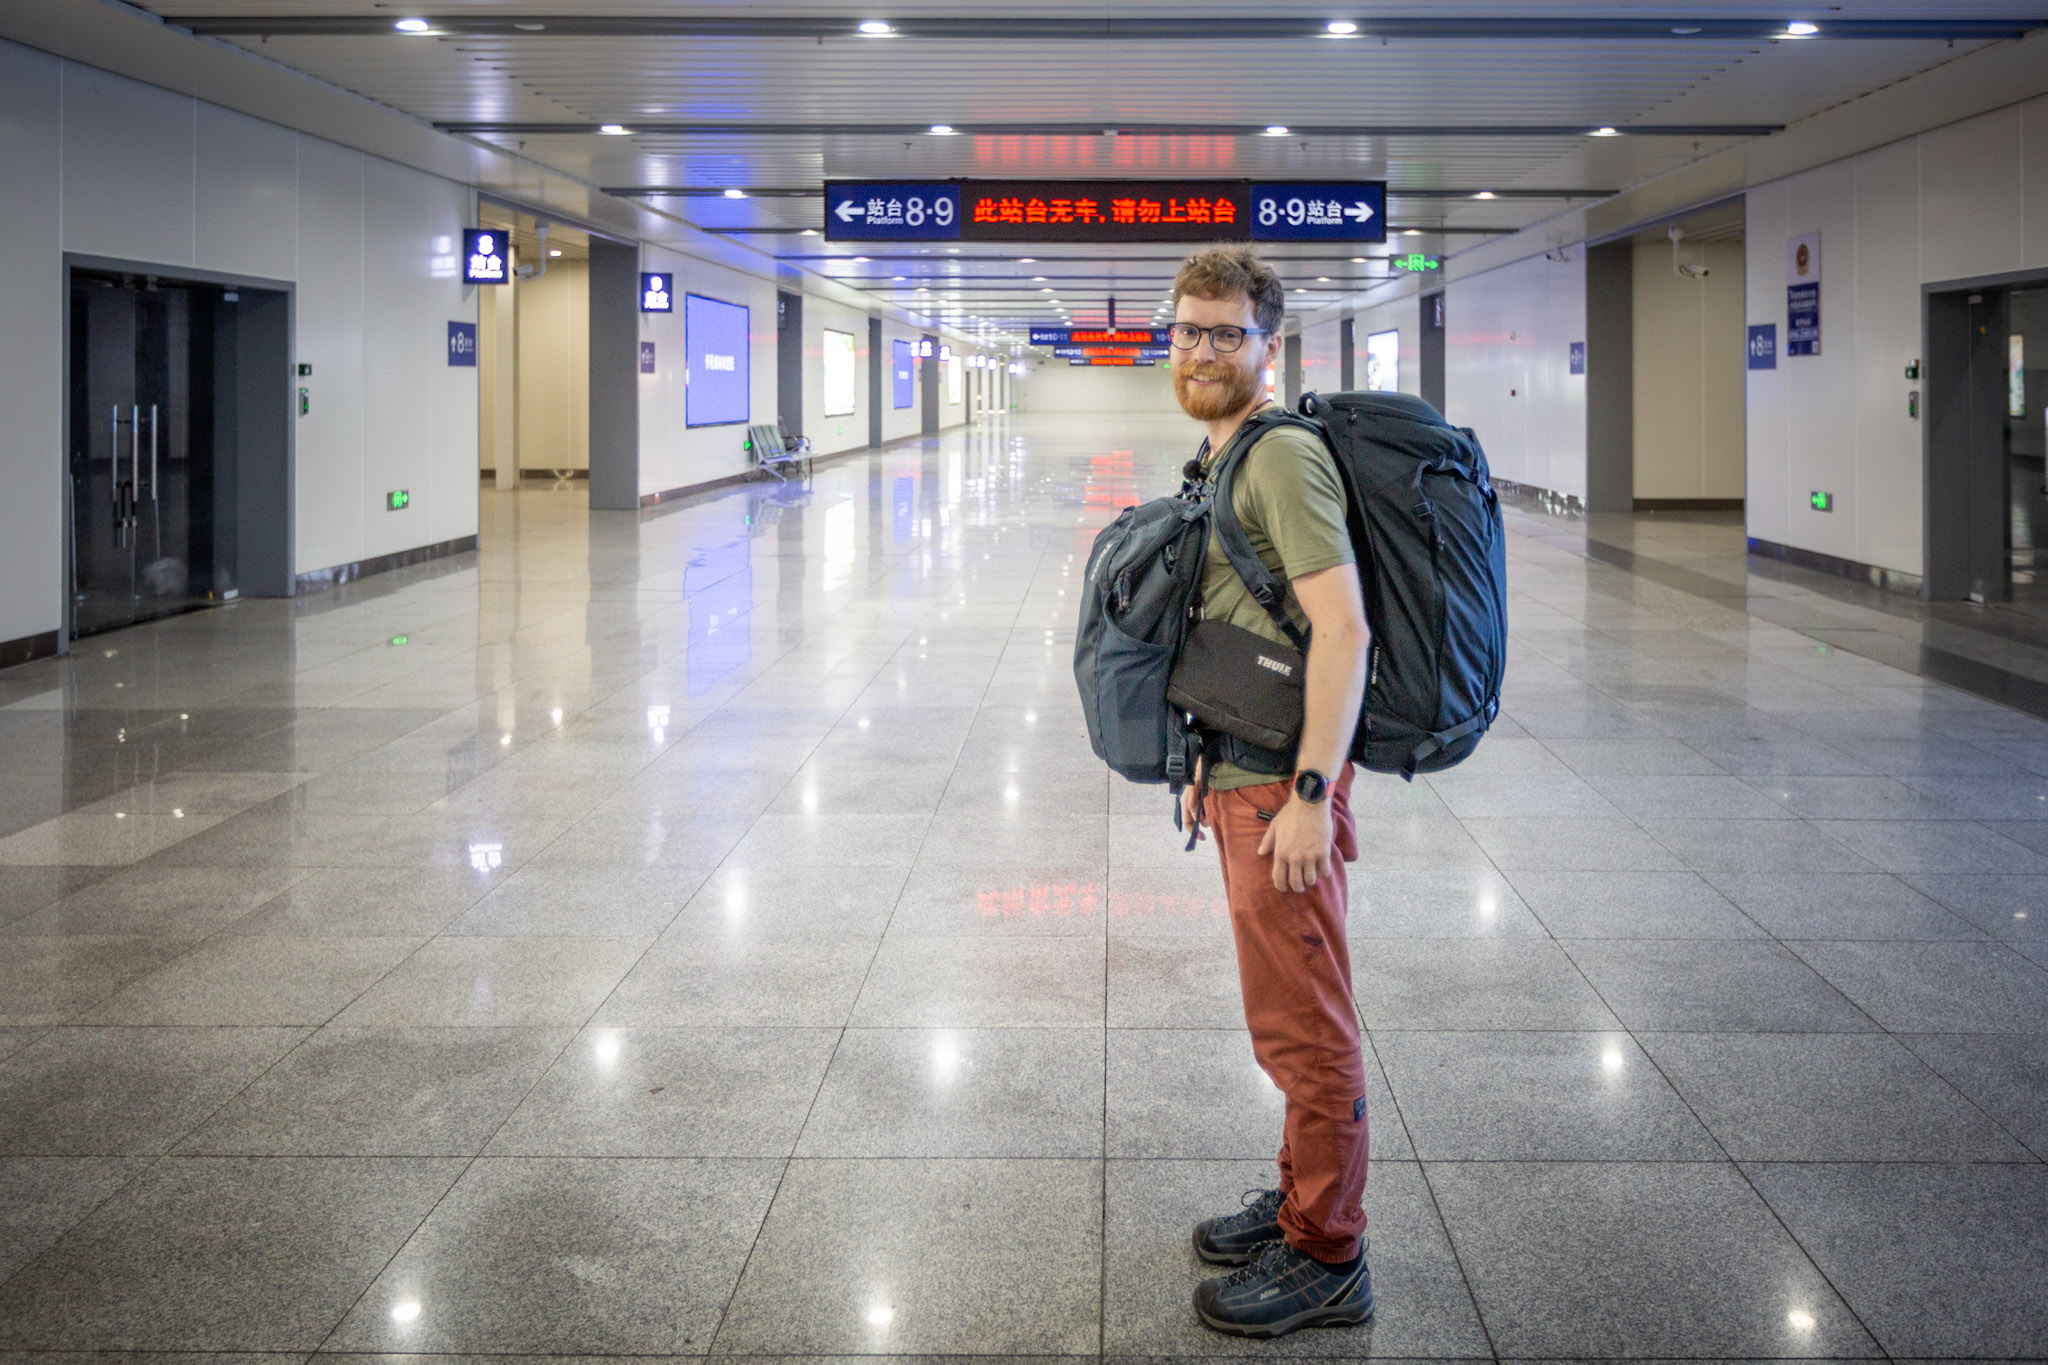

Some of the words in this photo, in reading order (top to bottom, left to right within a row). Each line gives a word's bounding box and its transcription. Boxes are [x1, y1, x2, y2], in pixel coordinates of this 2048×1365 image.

[867, 198, 902, 217] 站台
[1306, 199, 1342, 217] 站台
[866, 216, 904, 225] Platform
[1306, 216, 1343, 225] Platform
[457, 331, 465, 354] 8
[1756, 334, 1764, 357] 8
[1257, 655, 1293, 676] THULE
